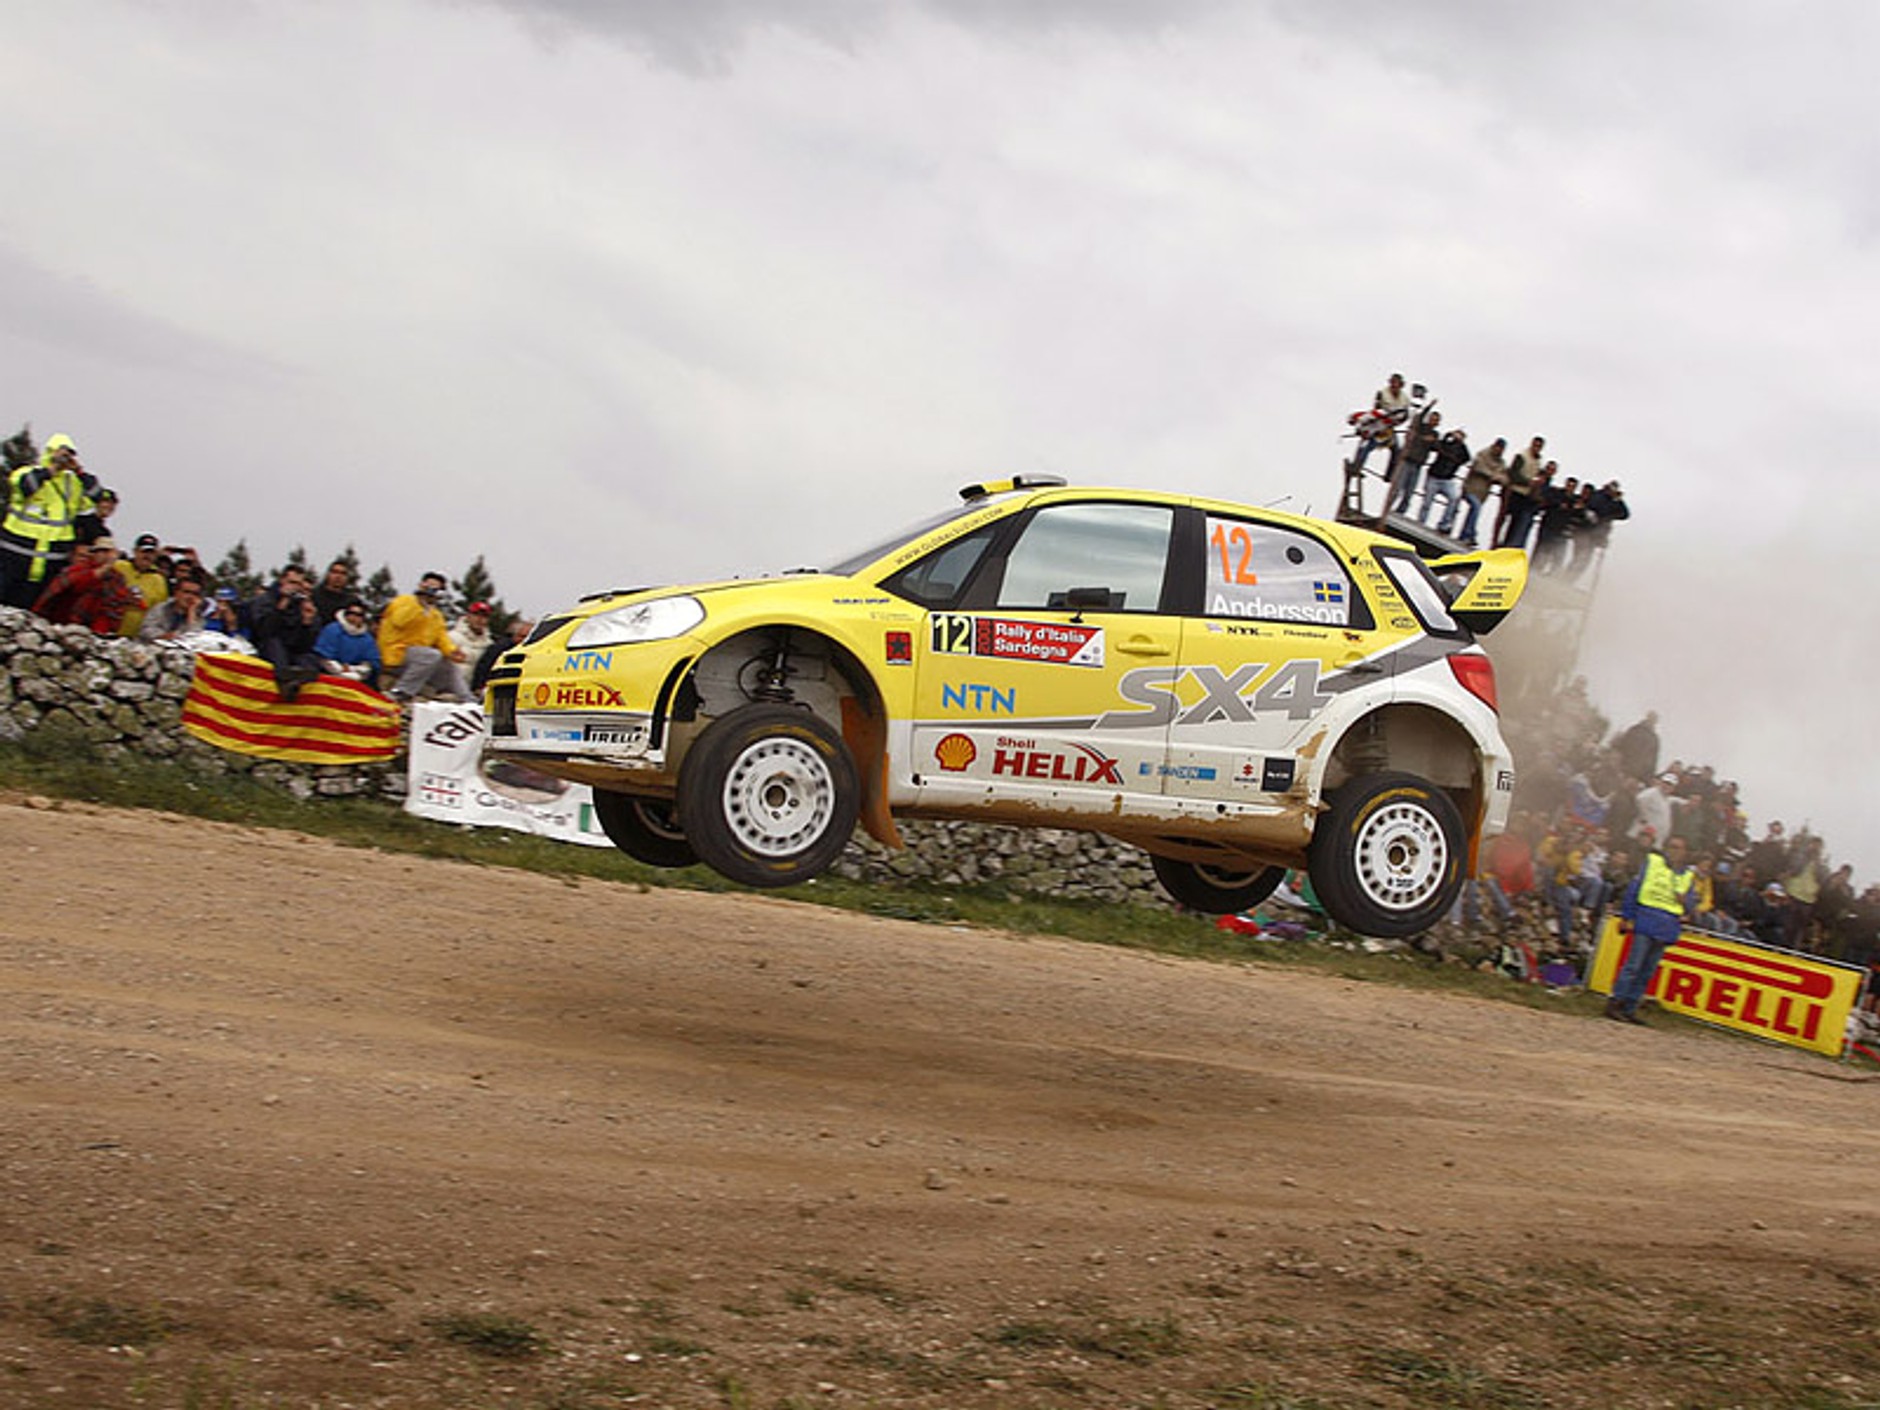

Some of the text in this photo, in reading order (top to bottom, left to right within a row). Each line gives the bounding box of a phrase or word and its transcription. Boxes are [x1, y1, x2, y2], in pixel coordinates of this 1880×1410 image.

[1211, 524, 1258, 585] 12
[1212, 594, 1348, 626] Andersson
[934, 616, 971, 653] 12
[995, 623, 1086, 643] Rally d'Italia
[564, 652, 613, 671] NTN
[995, 638, 1068, 659] Sardegna
[557, 684, 625, 706] HELIX
[942, 683, 1016, 713] NTN
[1092, 659, 1332, 730] SX4
[996, 737, 1036, 750] Shell
[992, 746, 1124, 785] HELIX
